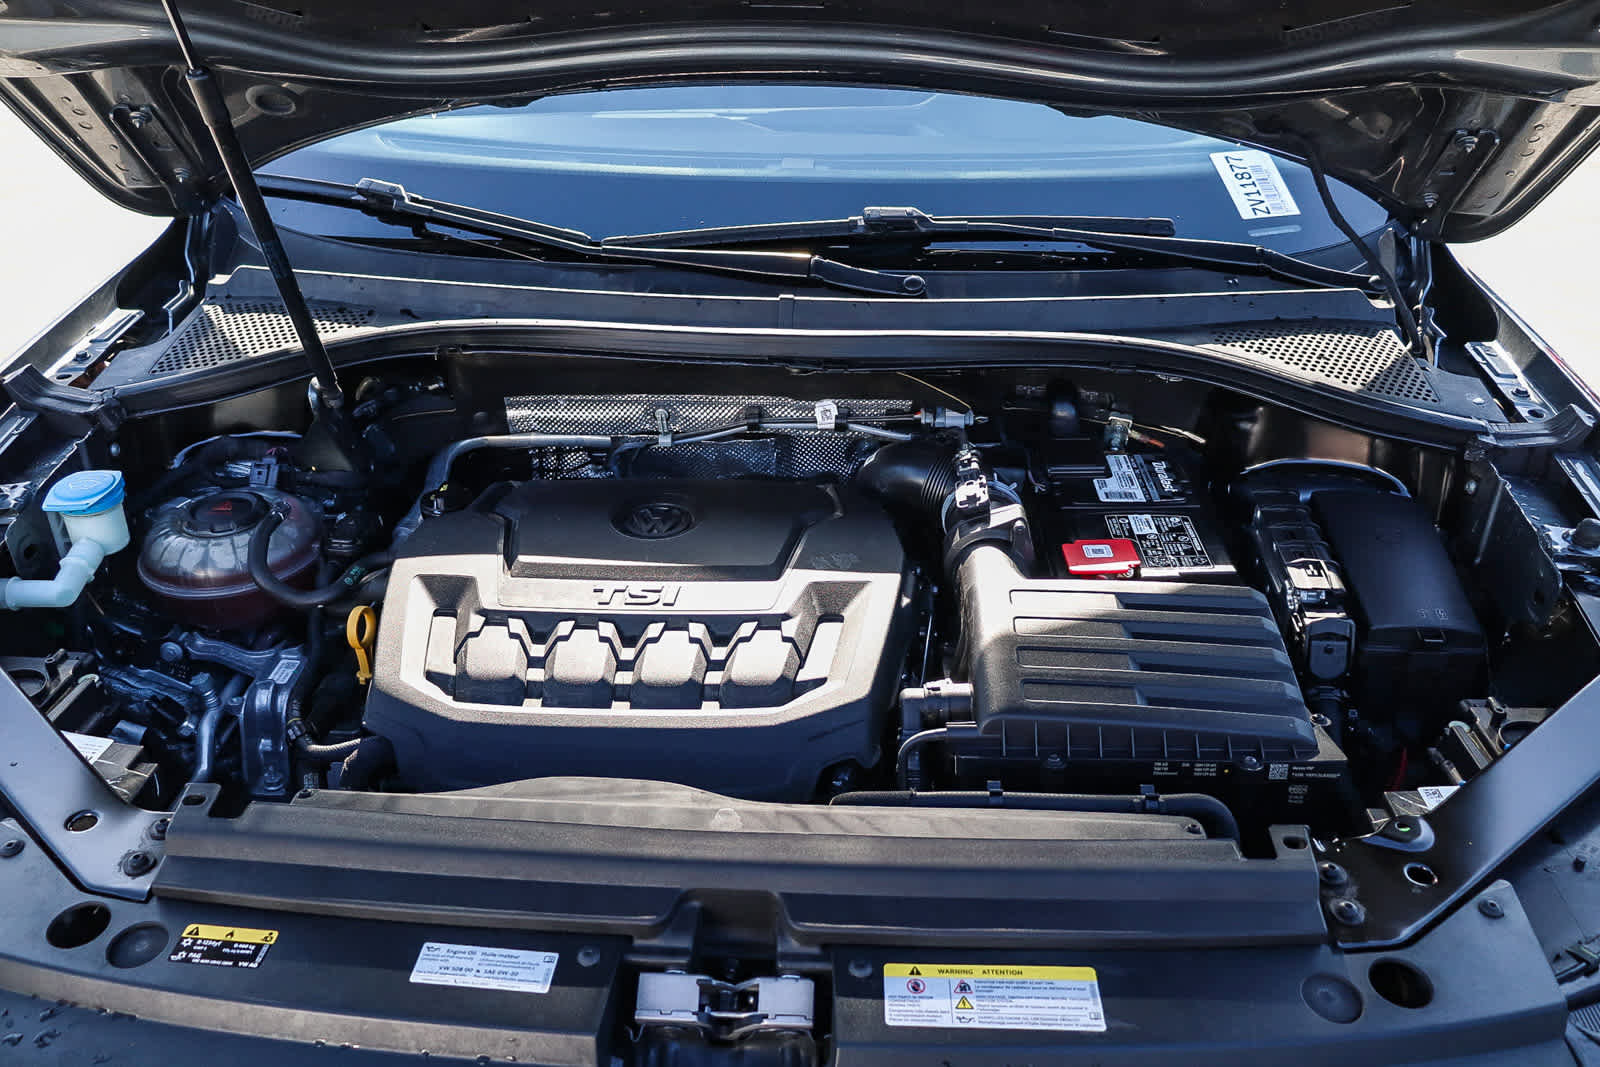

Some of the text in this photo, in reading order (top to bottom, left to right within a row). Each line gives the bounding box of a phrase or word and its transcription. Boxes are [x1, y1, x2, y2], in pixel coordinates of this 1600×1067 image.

[1224, 155, 1271, 216] ZV11877
[592, 585, 682, 607] TSI
[937, 967, 1023, 976] WARNING ATTENTION
